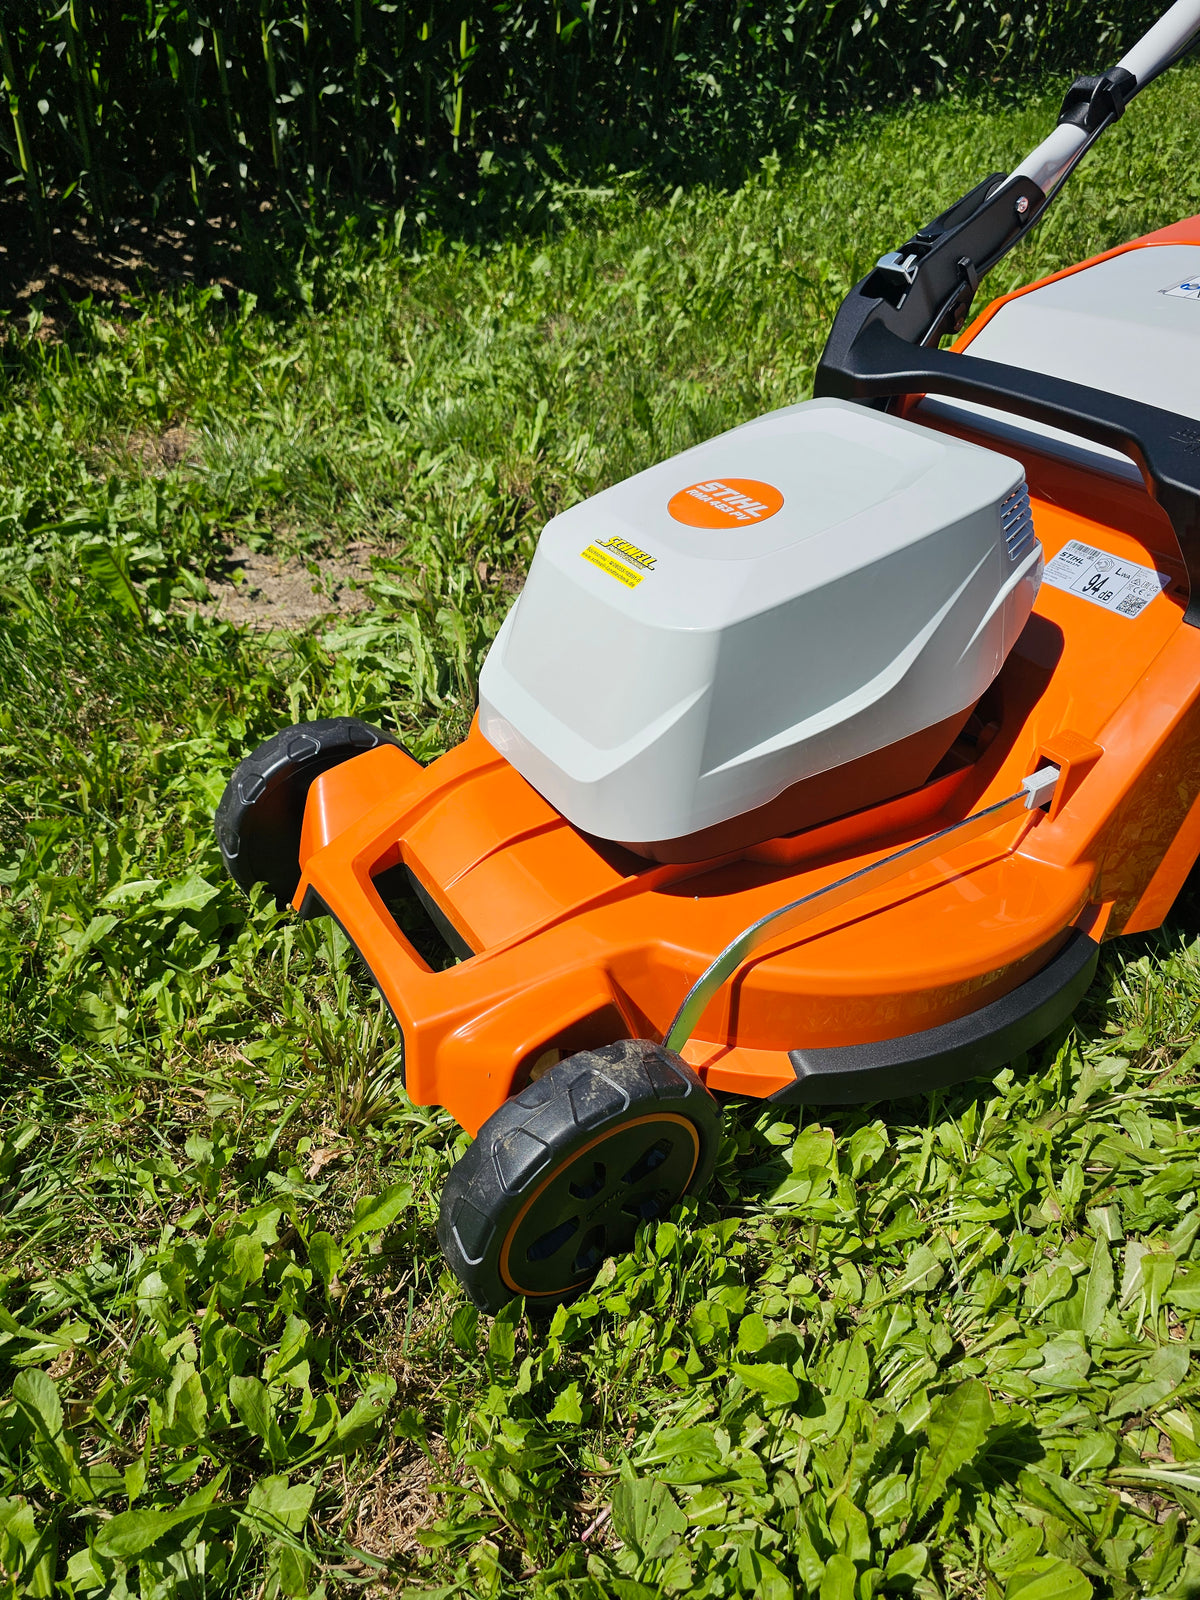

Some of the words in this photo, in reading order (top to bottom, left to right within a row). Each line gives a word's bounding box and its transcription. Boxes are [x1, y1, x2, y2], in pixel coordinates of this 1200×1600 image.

[685, 489, 713, 502] RMA
[728, 511, 751, 520] PV
[696, 481, 769, 518] STIHL
[594, 535, 658, 571] SCHNELL
[1060, 551, 1085, 565] STIHL
[1082, 573, 1110, 596] 94
[1097, 590, 1114, 602] dB
